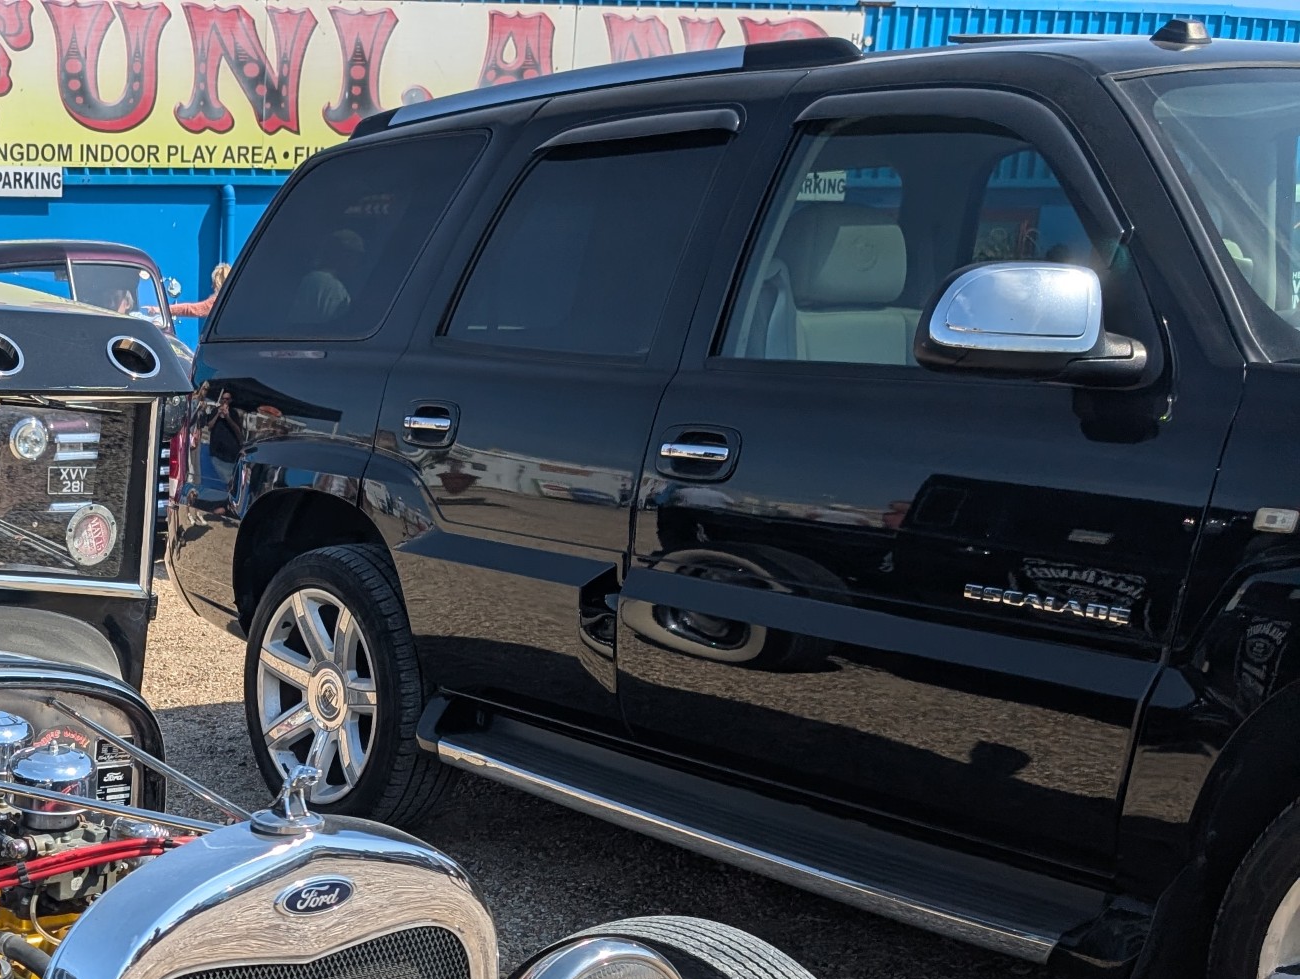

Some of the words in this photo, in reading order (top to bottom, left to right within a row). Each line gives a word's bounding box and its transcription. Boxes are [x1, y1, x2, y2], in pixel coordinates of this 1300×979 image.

[79, 144, 164, 164] INDOOR
[167, 145, 218, 165] PLAY
[222, 145, 278, 164] AREA
[60, 468, 88, 480] XVV
[296, 884, 340, 910] Ford
